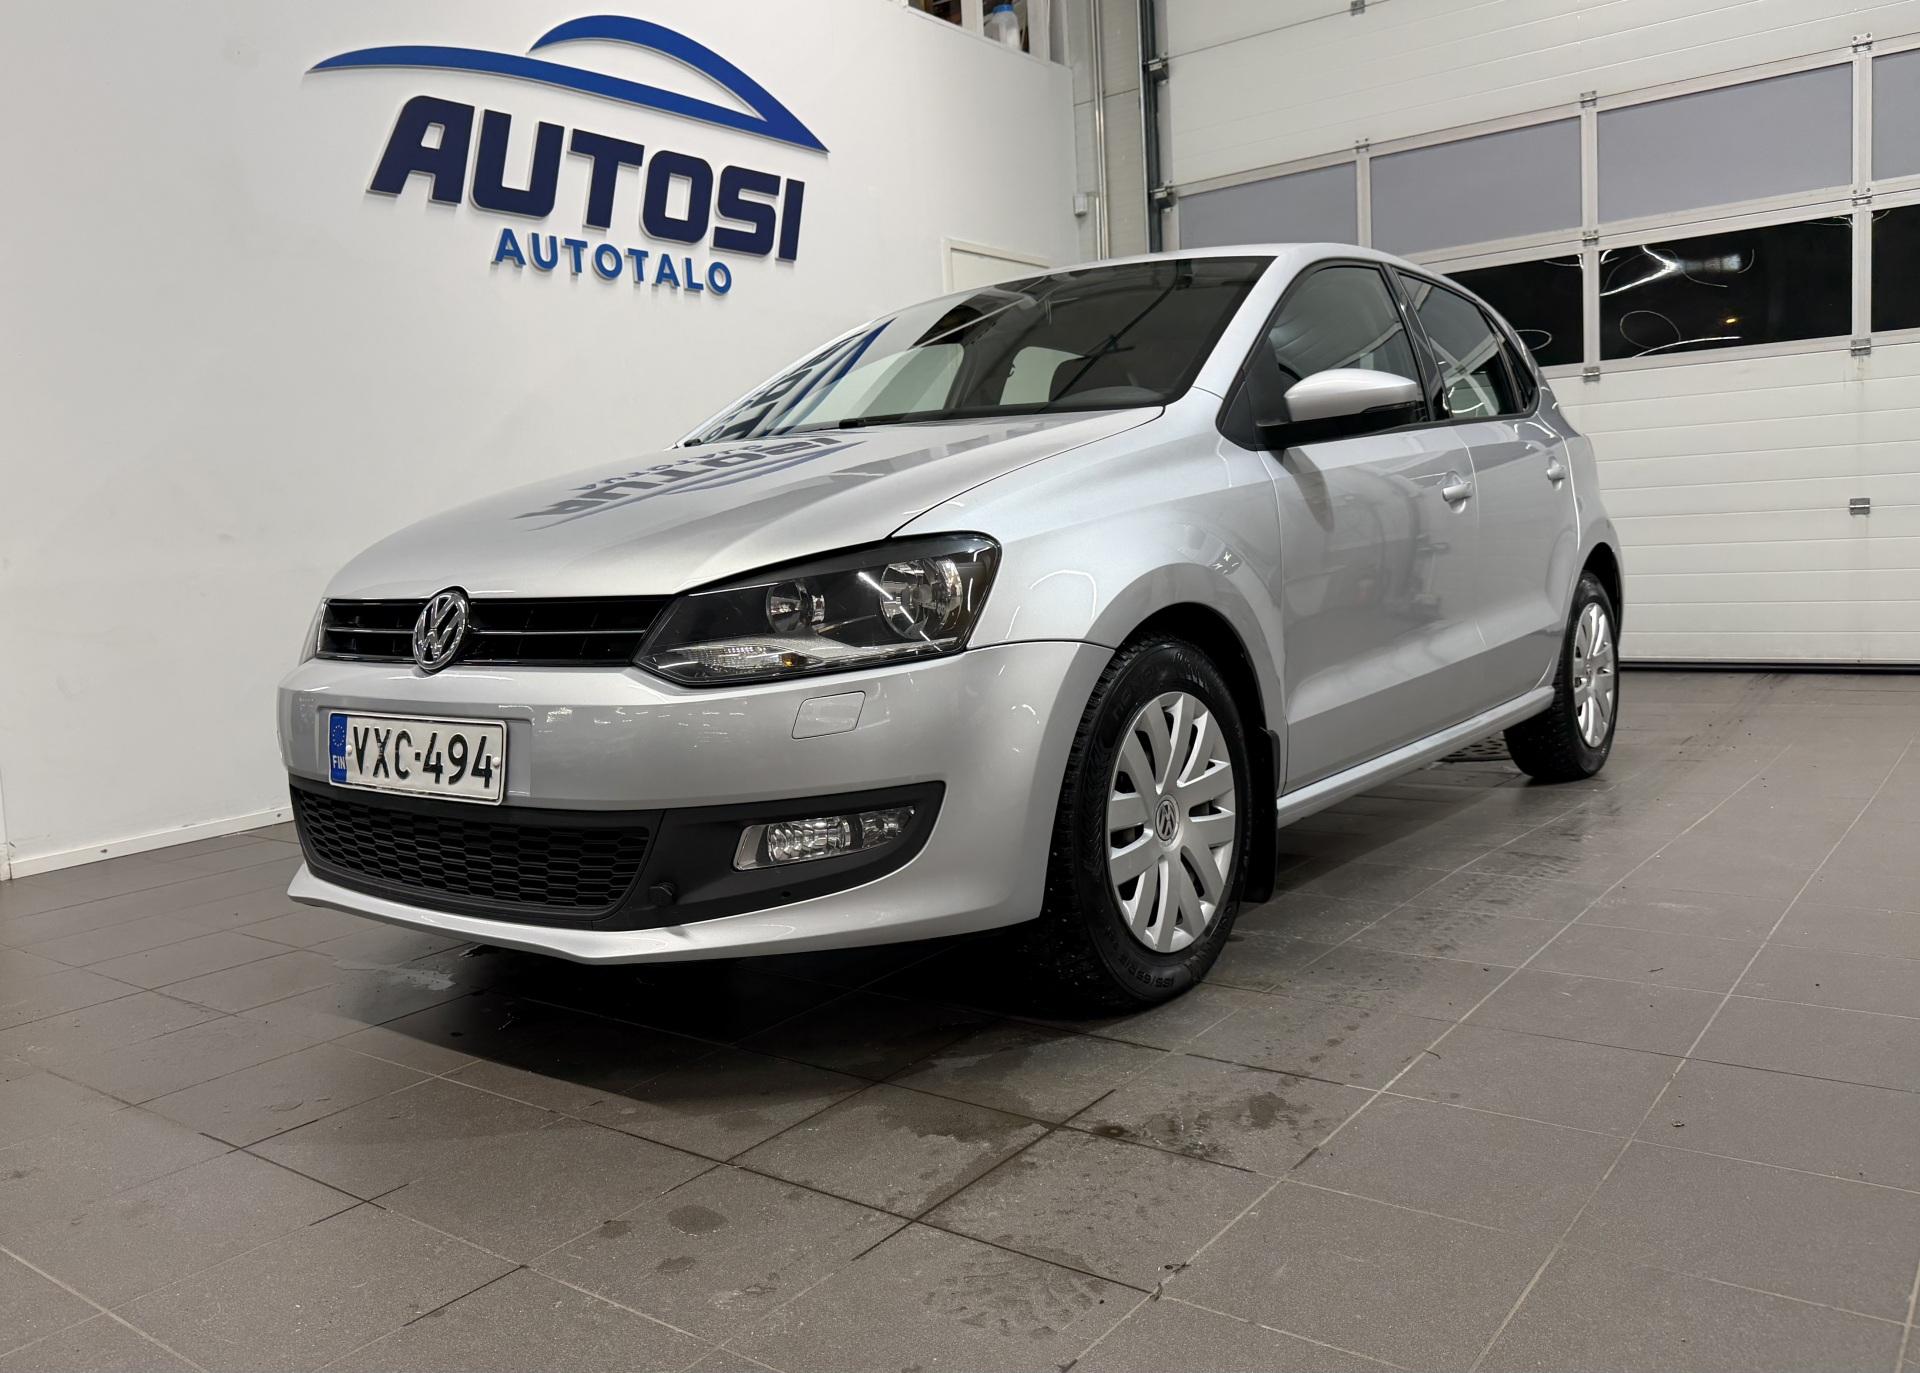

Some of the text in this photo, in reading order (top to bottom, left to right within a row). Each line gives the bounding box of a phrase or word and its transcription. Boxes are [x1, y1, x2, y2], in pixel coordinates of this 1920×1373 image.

[367, 95, 805, 262] AUTOSI
[492, 228, 732, 295] AUTOTALO
[332, 754, 347, 770] FIN
[352, 726, 493, 789] VXC-494
